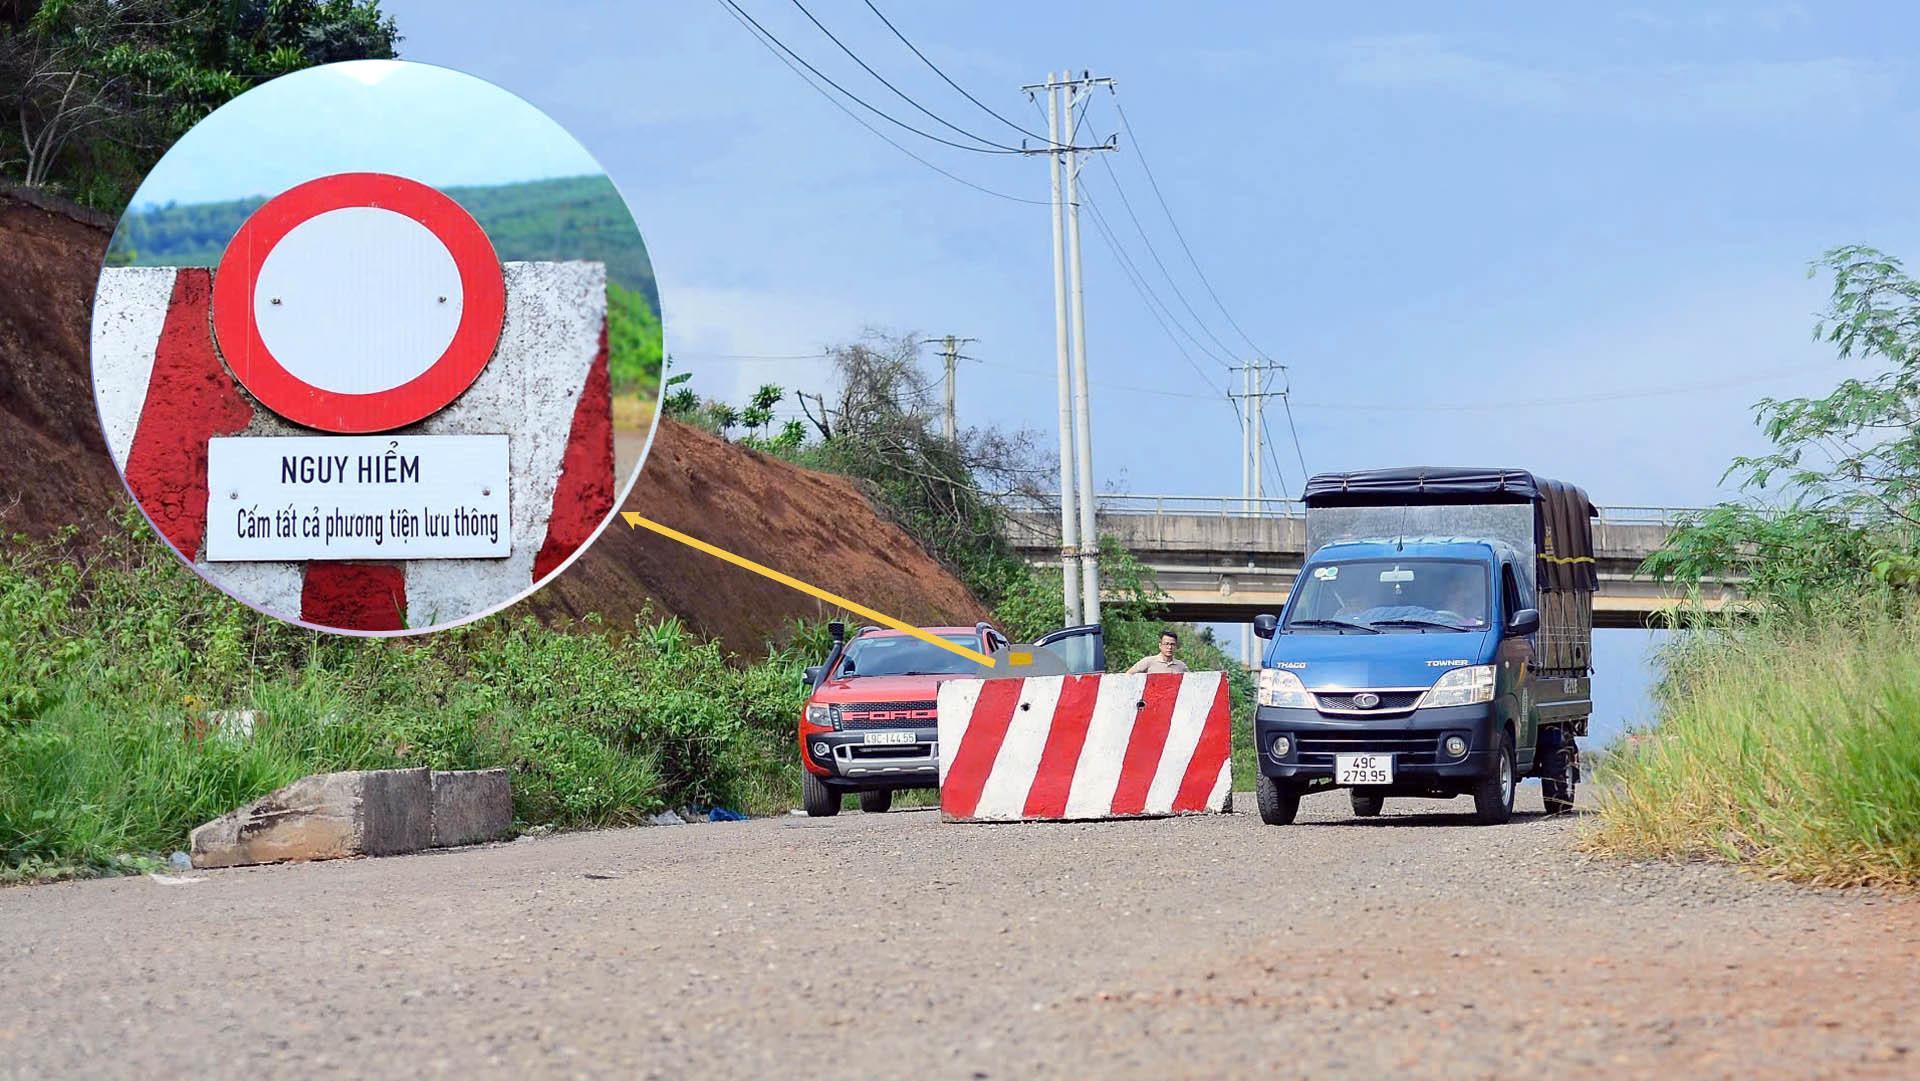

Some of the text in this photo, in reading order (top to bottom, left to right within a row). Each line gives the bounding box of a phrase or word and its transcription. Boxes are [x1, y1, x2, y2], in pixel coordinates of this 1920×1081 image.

[281, 440, 420, 484] NGUY HIỂM
[237, 503, 499, 545] Cấm tất cả phương tiện lưu thông
[1426, 659, 1469, 667] TOWNER
[841, 709, 937, 721] FORD
[1352, 757, 1377, 769] 49C
[1343, 770, 1387, 782] 279.95
